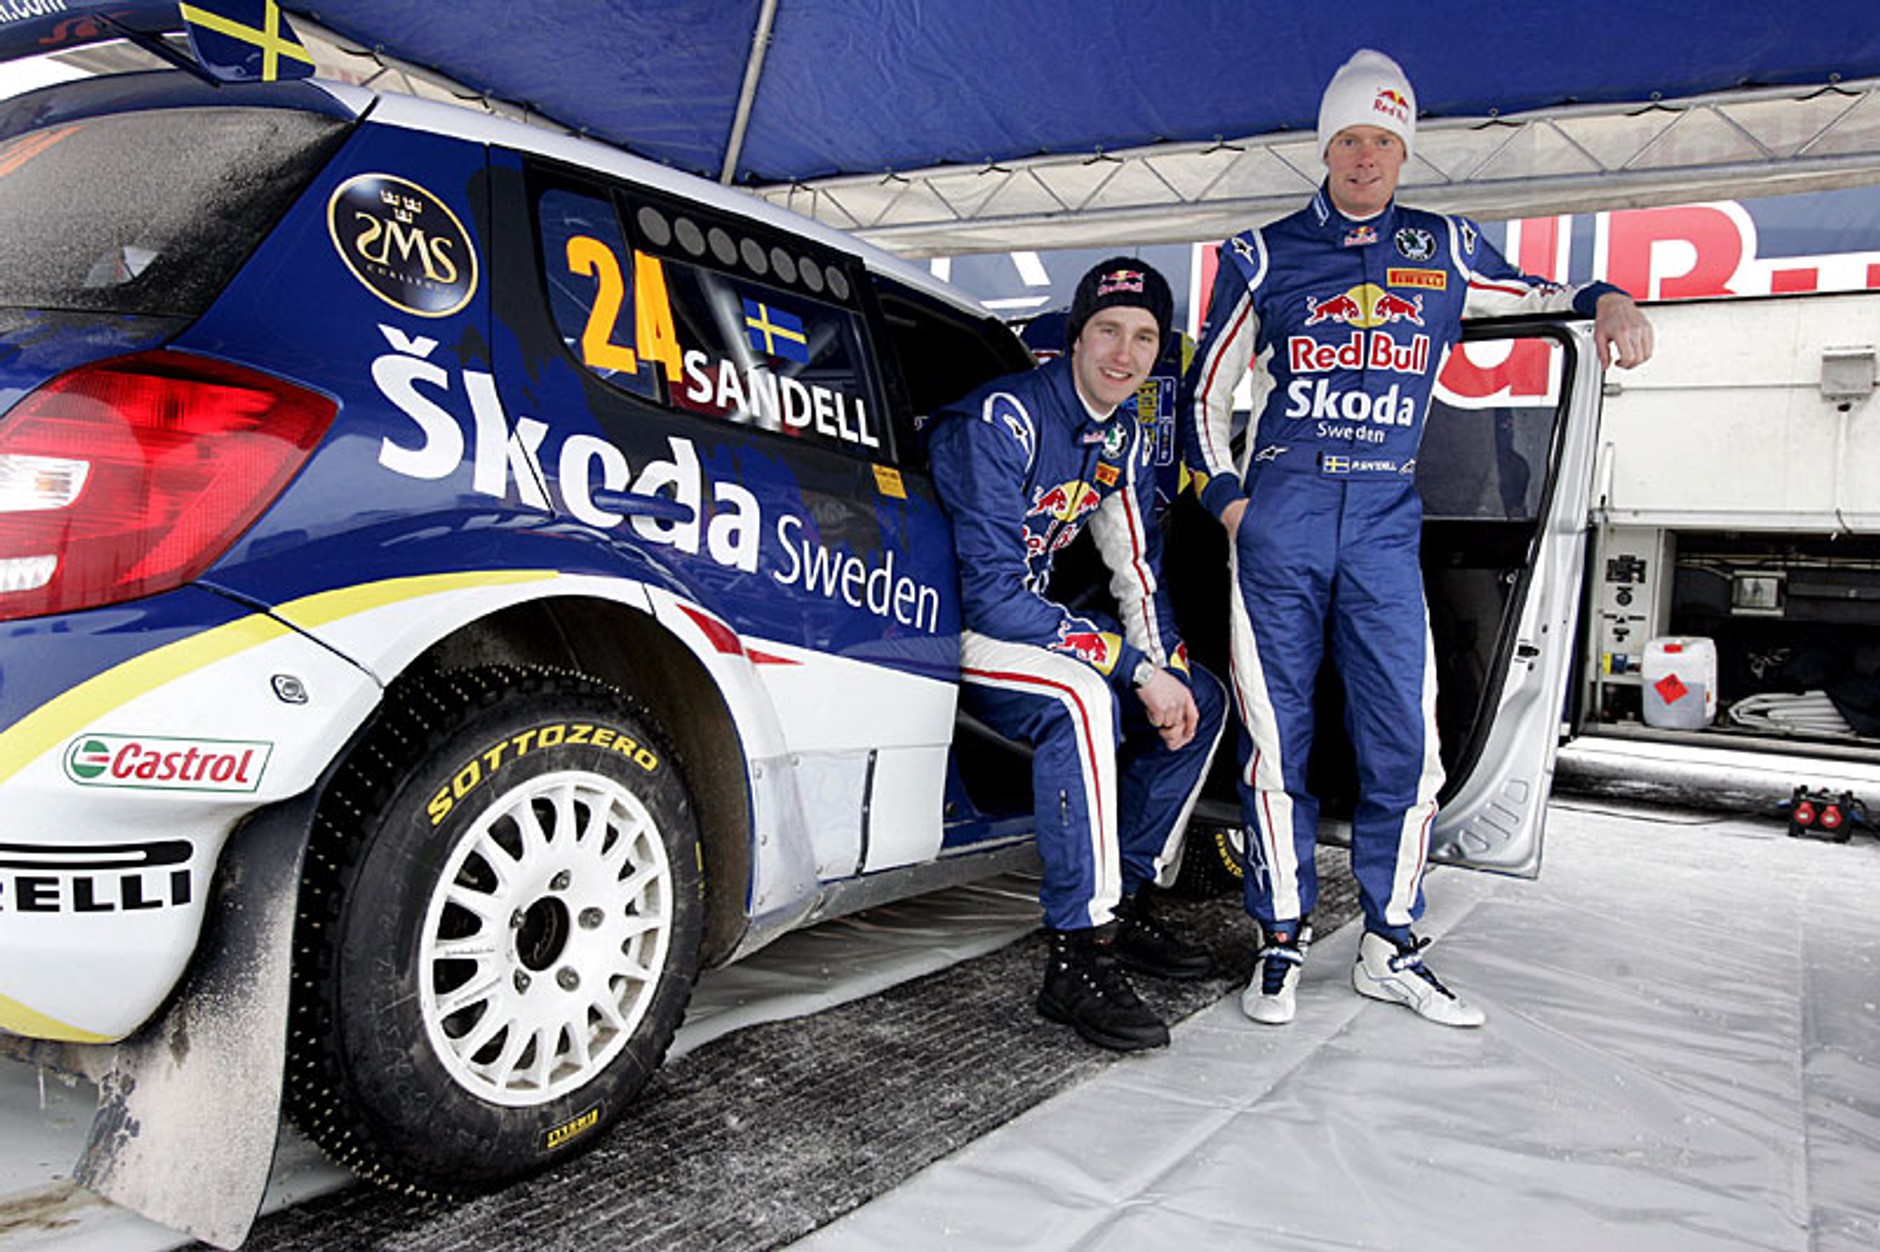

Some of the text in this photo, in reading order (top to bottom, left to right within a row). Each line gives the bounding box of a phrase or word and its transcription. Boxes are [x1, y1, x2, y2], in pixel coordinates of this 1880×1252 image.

[566, 235, 682, 384] 24
[1289, 331, 1430, 376] Red Bull
[682, 350, 880, 449] SANDELL
[1316, 421, 1386, 443] Sweden
[773, 514, 940, 633] Sweden
[111, 743, 255, 784] Castrol
[427, 724, 660, 826] SOTTOZERO
